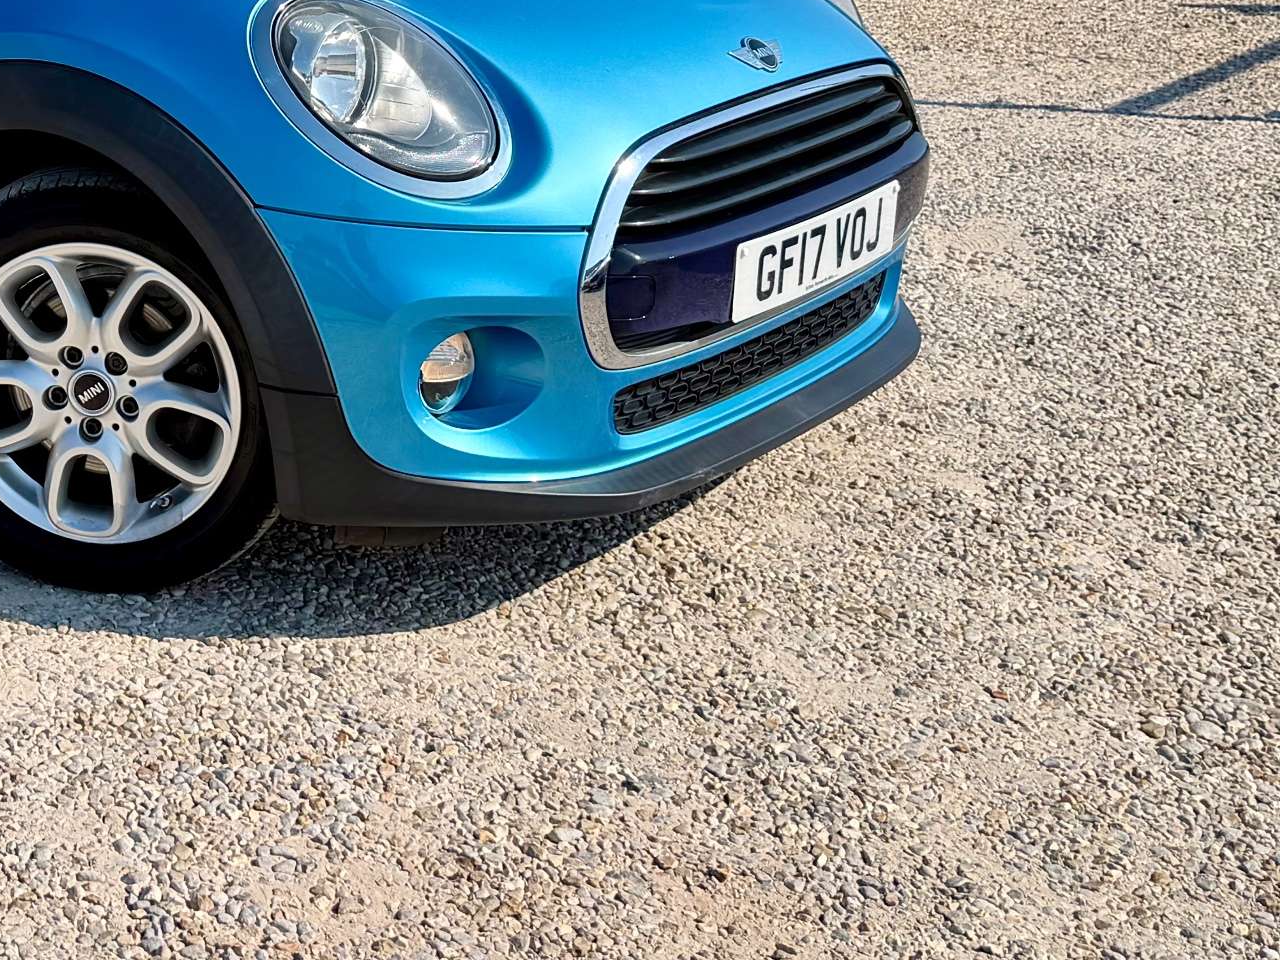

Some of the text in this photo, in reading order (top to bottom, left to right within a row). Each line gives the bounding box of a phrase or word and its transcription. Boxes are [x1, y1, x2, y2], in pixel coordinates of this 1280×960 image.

[756, 197, 884, 302] GF17 VOJ
[78, 381, 105, 404] MINI
